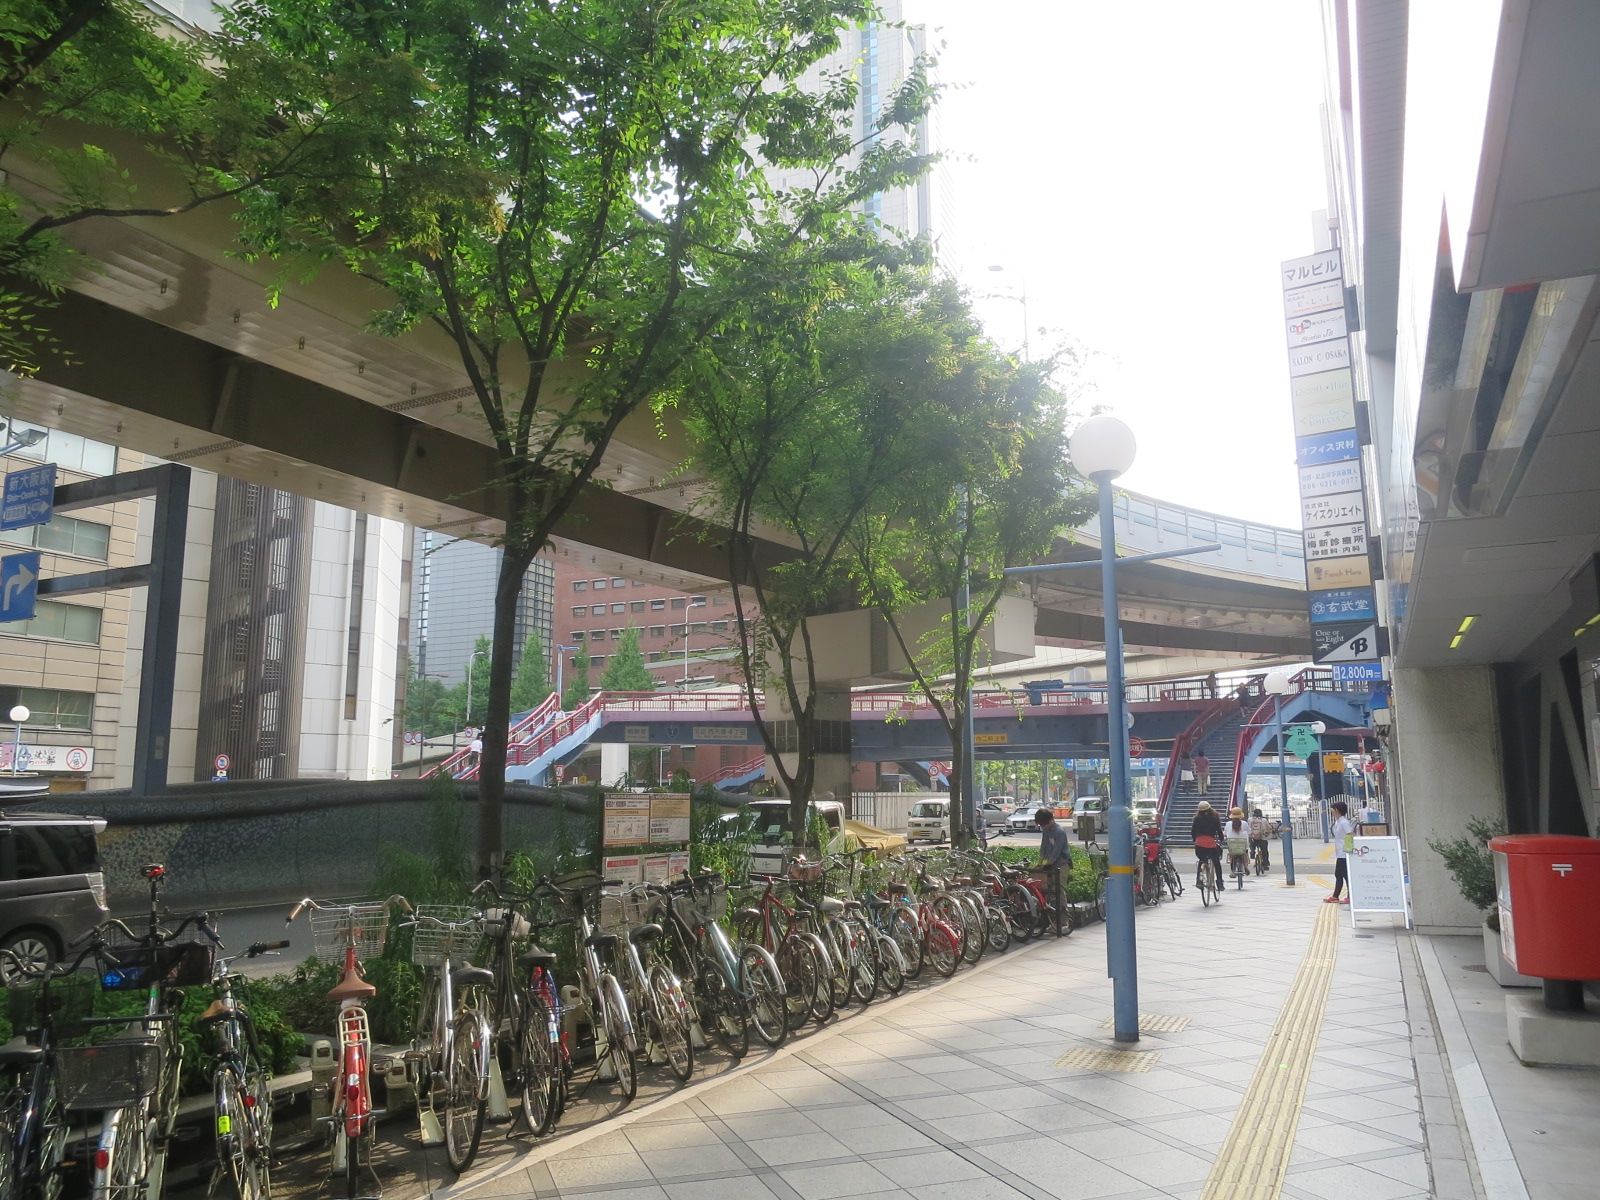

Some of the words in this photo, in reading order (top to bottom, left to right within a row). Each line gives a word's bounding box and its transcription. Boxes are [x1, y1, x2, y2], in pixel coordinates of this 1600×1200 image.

[1284, 260, 1337, 281] マルビル
[1325, 349, 1347, 361] OSAKA
[1301, 439, 1354, 456] オフィス沢村
[9, 469, 50, 491] 新大阪駅
[1351, 526, 1363, 534] 3F
[1307, 535, 1364, 549] 梅新診療所
[1326, 599, 1369, 613] 玄武堂
[1315, 629, 1331, 637] One
[1325, 634, 1344, 644] Eight
